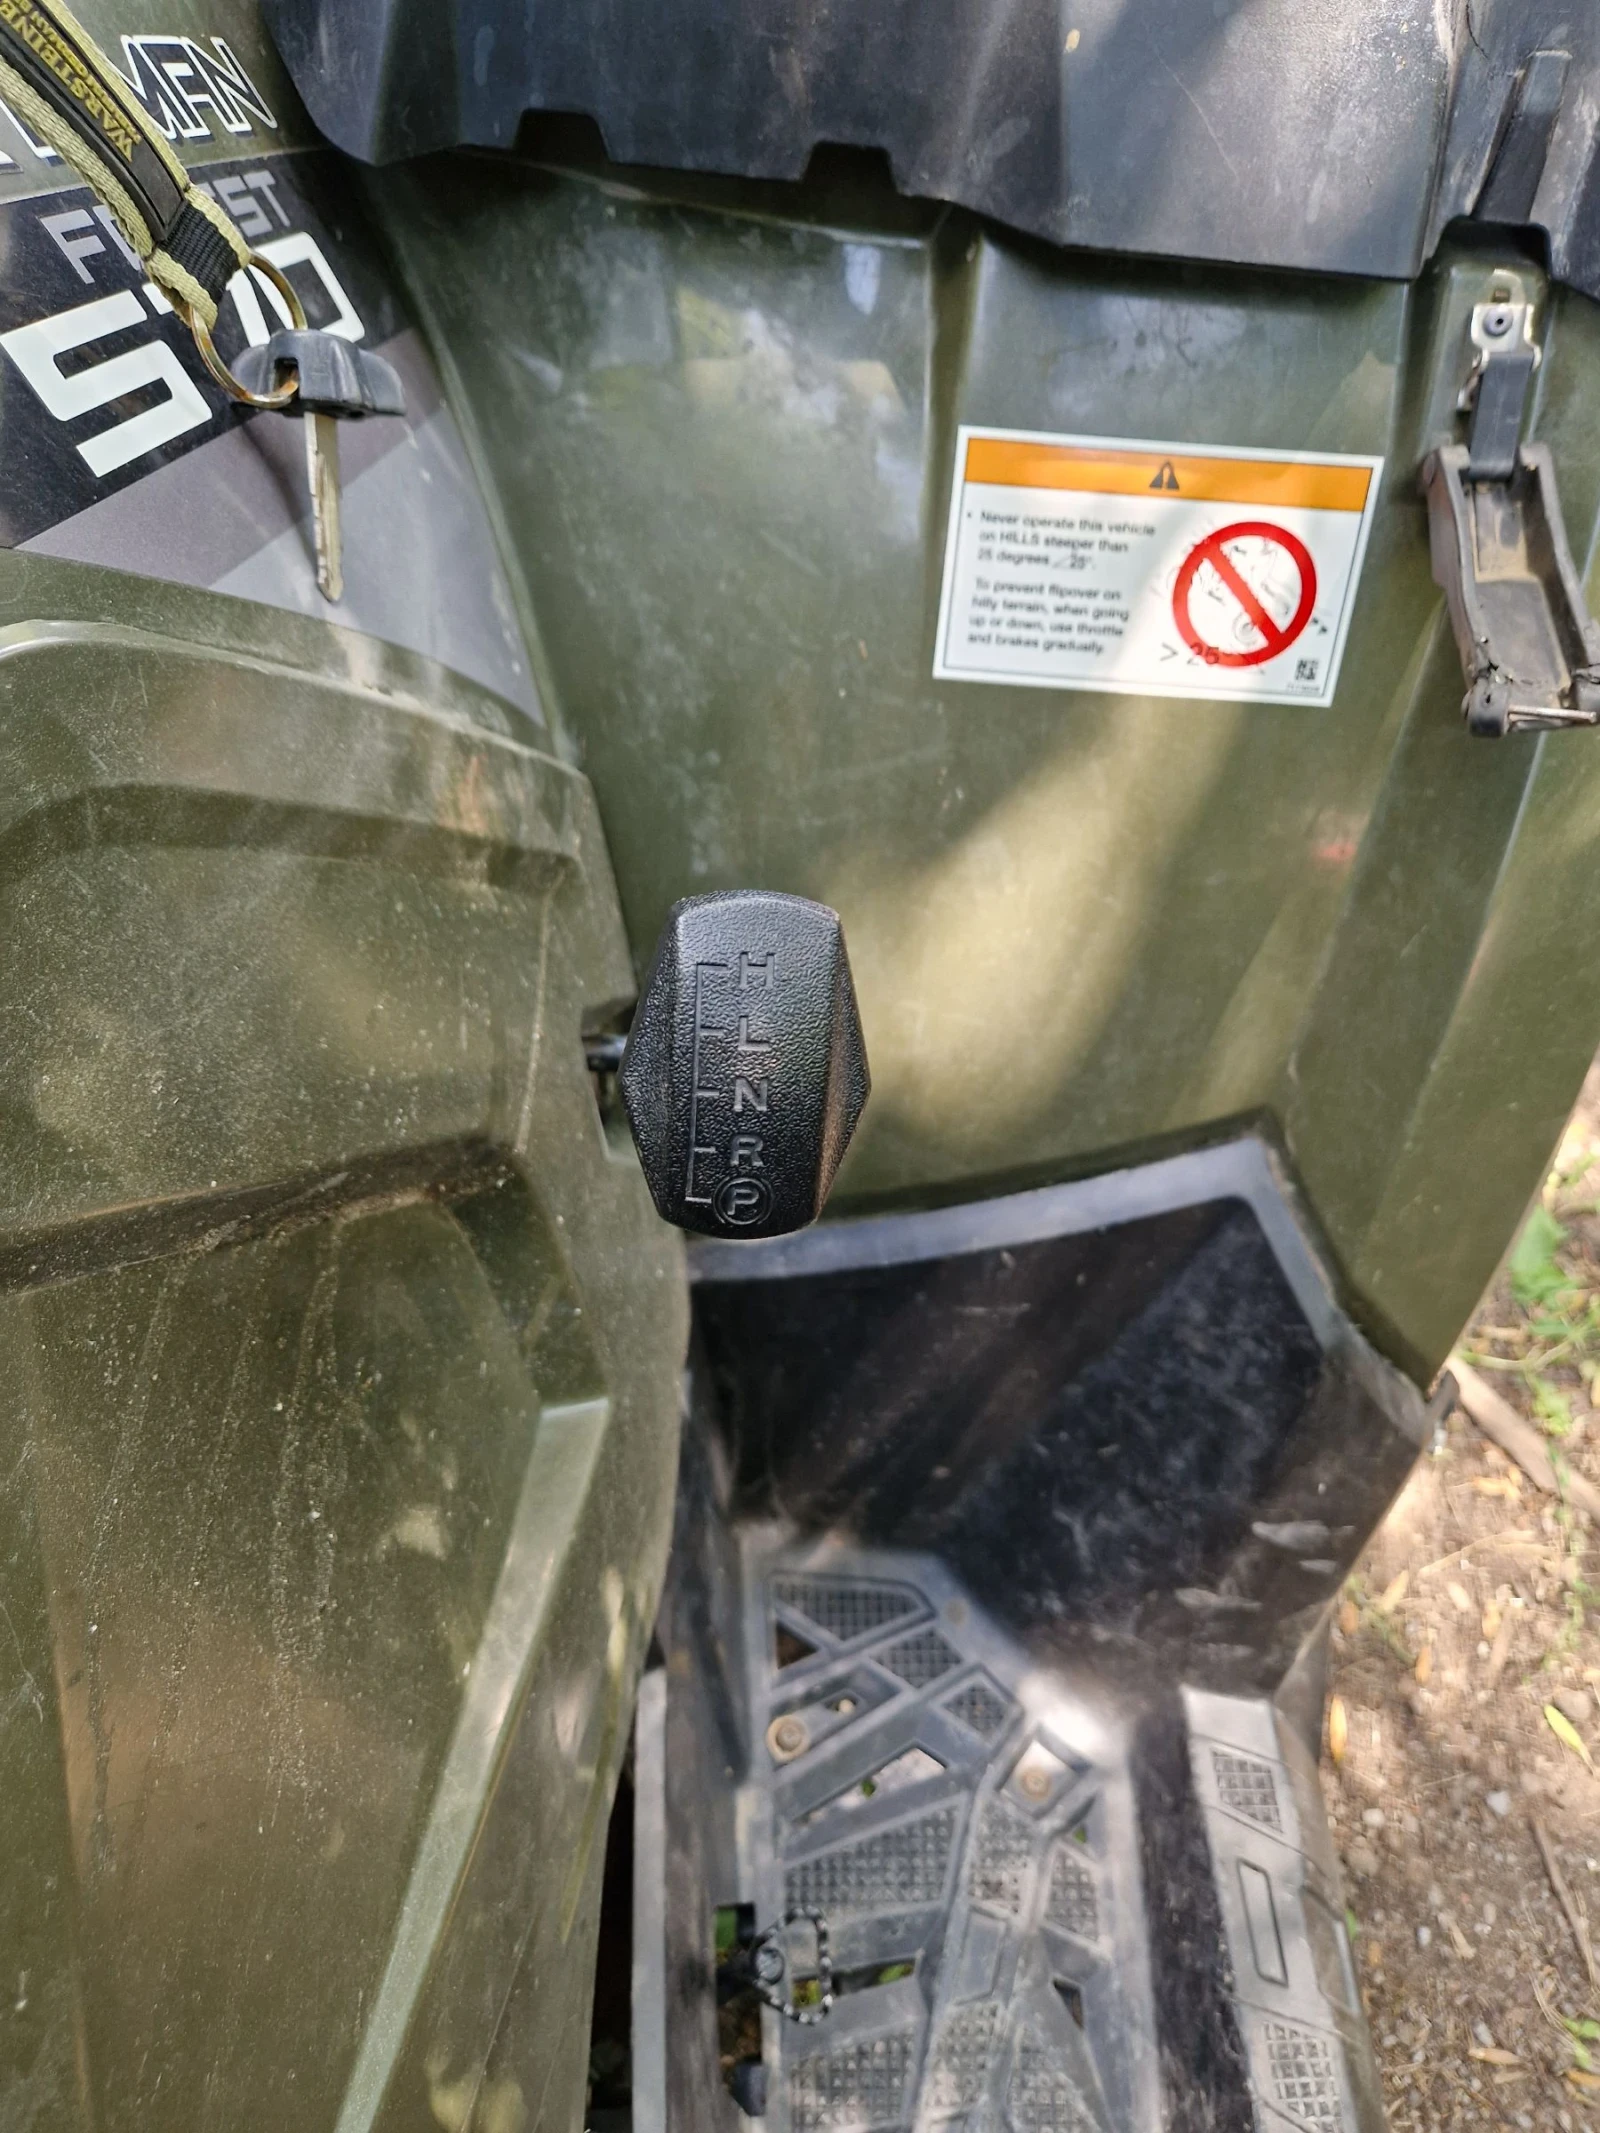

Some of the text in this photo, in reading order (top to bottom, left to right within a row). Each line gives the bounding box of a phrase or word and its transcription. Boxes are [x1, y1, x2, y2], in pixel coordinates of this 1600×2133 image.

[0, 0, 132, 162] WARSTEINE
[981, 511, 1156, 536] Never operate this vehicle
[1000, 534, 1039, 546] HILLS
[1044, 536, 1094, 551] steeper
[1099, 539, 1129, 552] than
[997, 549, 1049, 566] degrees
[993, 580, 1045, 594] prevent
[1049, 583, 1099, 599] flipover
[1054, 603, 1088, 616] when
[1092, 608, 1129, 622] going
[968, 632, 992, 644] and
[996, 633, 1038, 648] brakes
[1077, 621, 1123, 637] throttle
[739, 951, 776, 989] H
[737, 1015, 772, 1051] L
[734, 1078, 768, 1112] N
[730, 1134, 765, 1167] R
[727, 1187, 760, 1216] P
